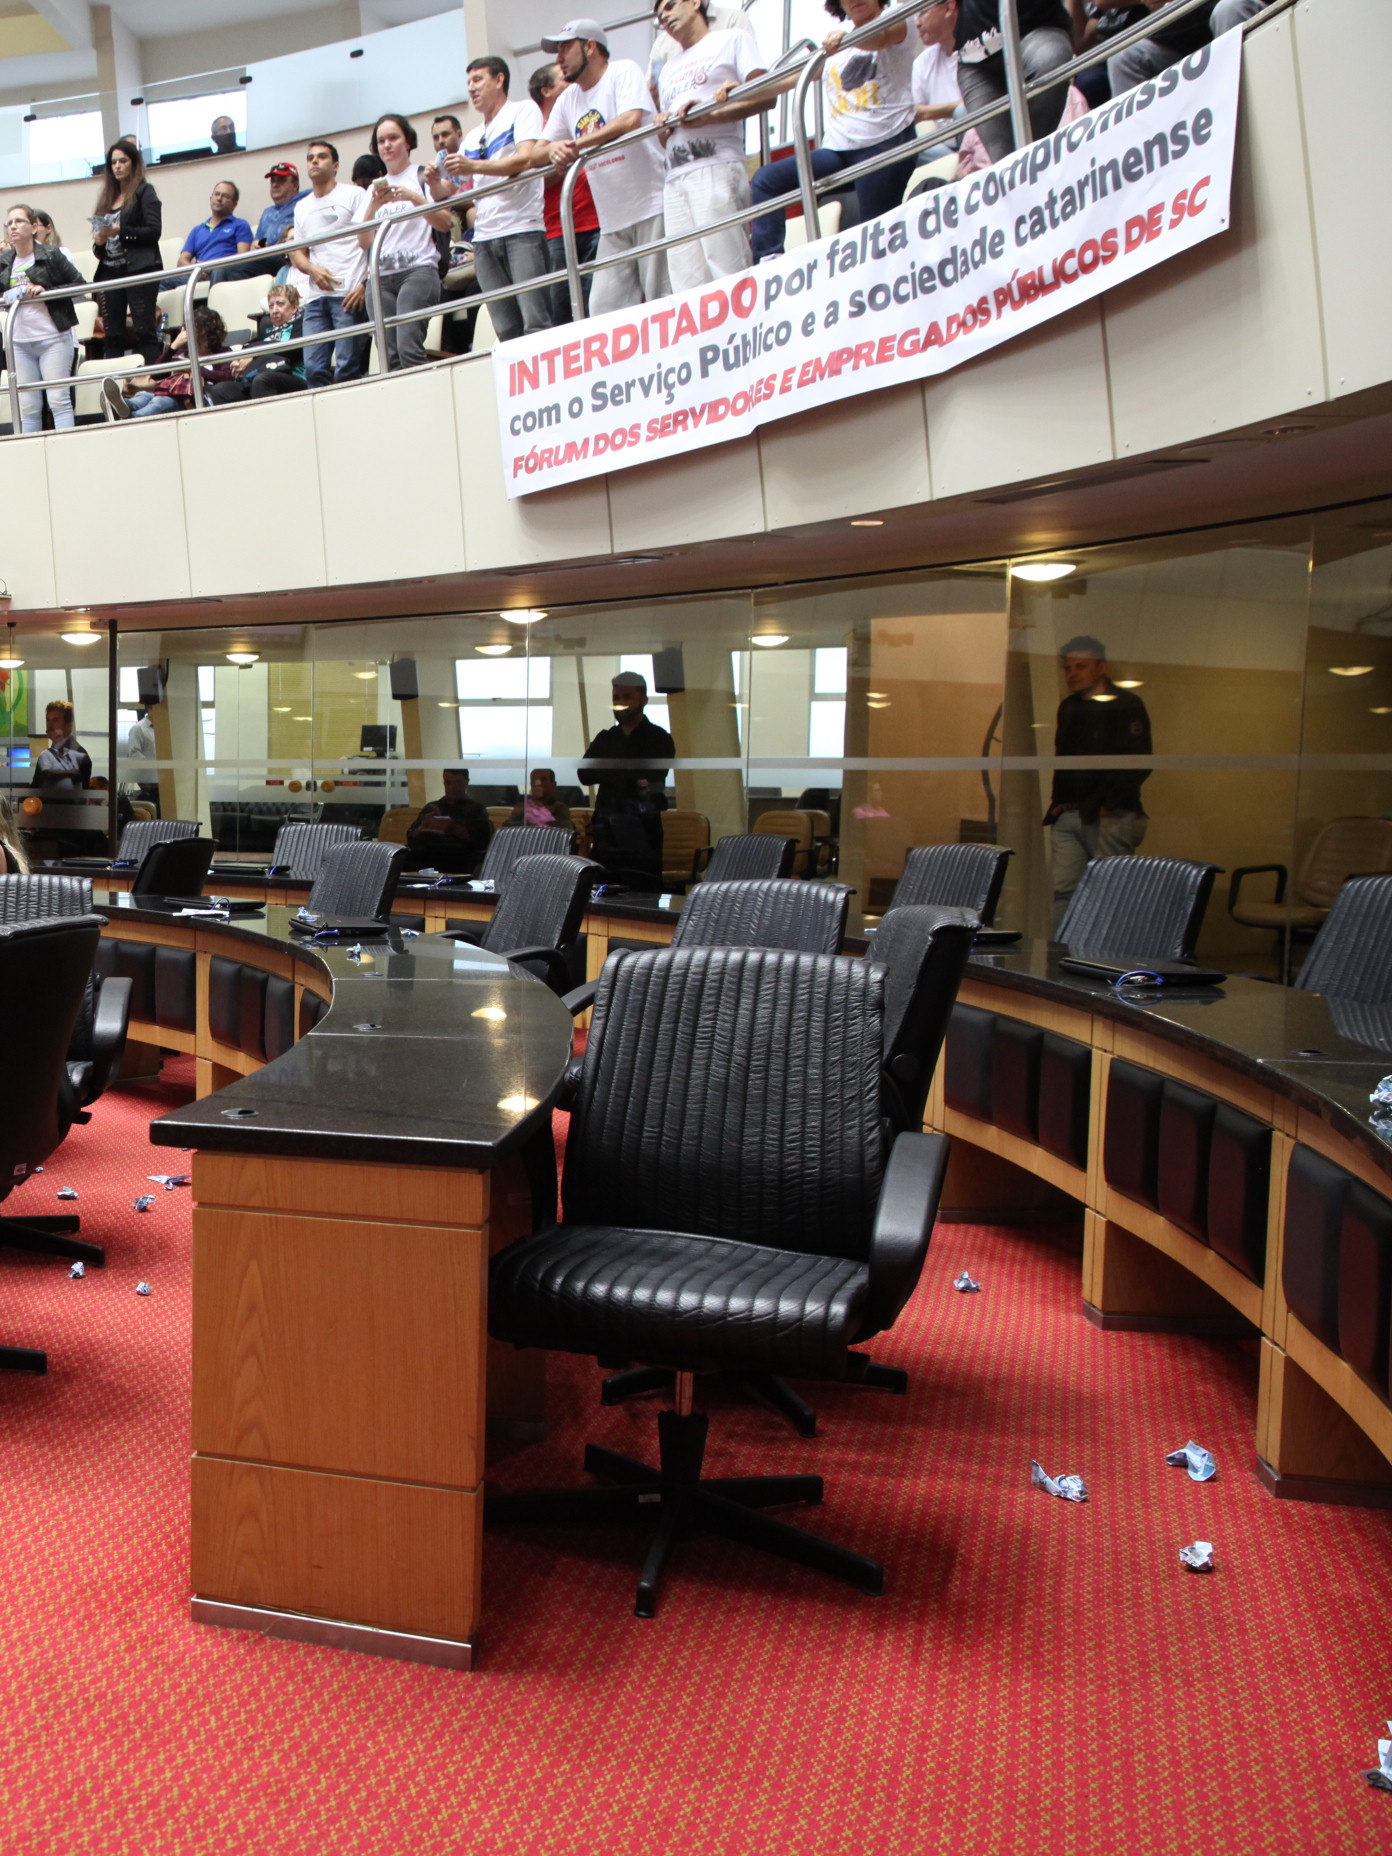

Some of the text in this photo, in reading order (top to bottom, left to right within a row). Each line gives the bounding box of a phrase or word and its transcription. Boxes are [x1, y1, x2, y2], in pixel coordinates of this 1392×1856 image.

[508, 44, 1211, 398] INTERDITADO por falta de compromisso
[510, 107, 1213, 436] com o Serviço Público e a sociedade catarinense
[512, 176, 1212, 479] FÓRUM DOS SERVIDORES E EMPREGADOS PÚBLICOS DE SC
